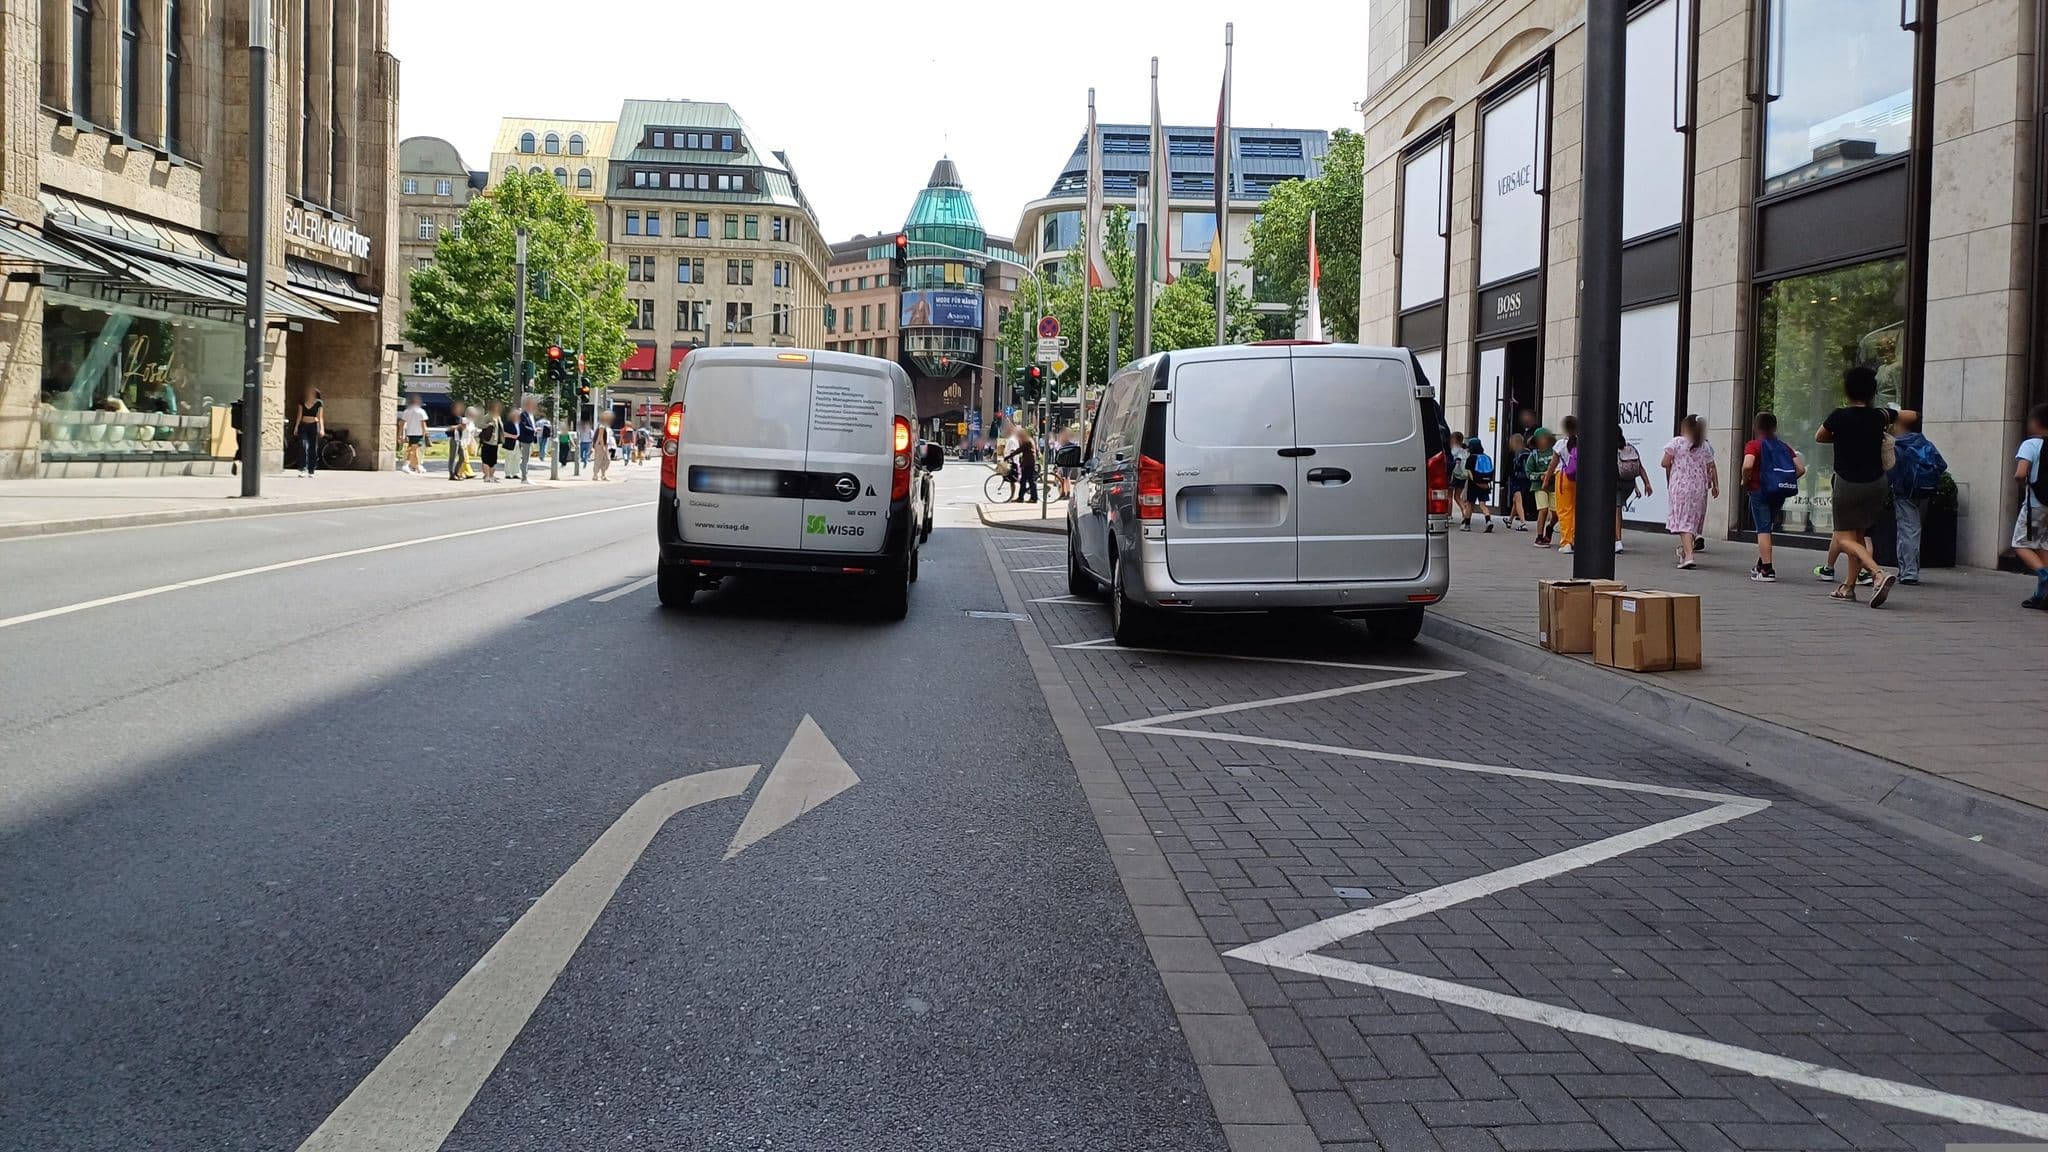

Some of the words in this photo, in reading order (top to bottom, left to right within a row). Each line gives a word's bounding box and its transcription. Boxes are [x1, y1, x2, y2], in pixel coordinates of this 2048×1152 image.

[1497, 165, 1531, 196] VERSACE
[284, 207, 327, 246] GALERIA
[1497, 292, 1521, 315] BOSS
[1618, 401, 1654, 425] RSACE
[694, 522, 750, 531] www.wisag.de
